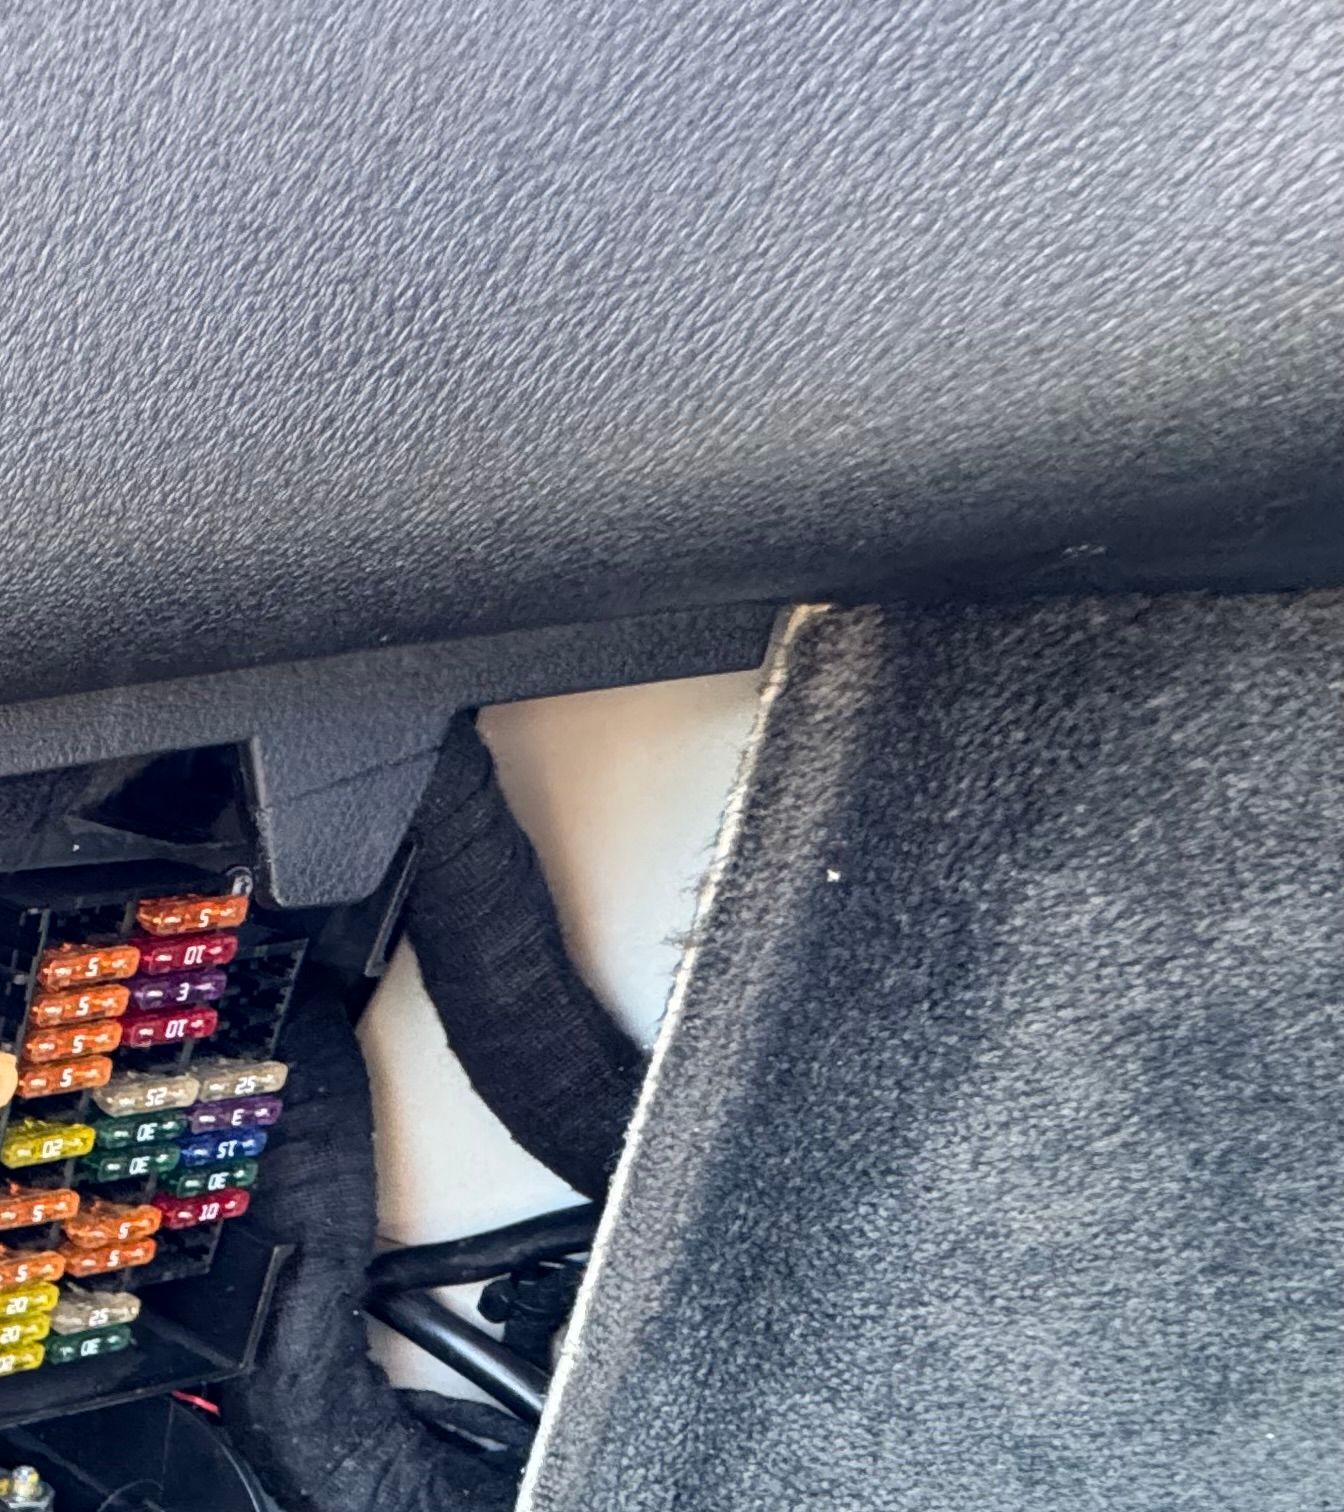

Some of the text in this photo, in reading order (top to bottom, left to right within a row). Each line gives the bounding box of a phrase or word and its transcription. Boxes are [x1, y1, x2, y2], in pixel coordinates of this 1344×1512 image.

[199, 909, 211, 928] 5
[183, 945, 207, 965] 10
[85, 957, 100, 977] 5
[76, 996, 90, 1016] 5
[165, 1019, 188, 1039] 10
[72, 1035, 85, 1054] 5
[60, 1067, 73, 1087] 5
[31, 1204, 44, 1223] 5
[198, 1202, 221, 1222] 10
[117, 1221, 130, 1240] 5
[107, 1249, 119, 1268] 5
[15, 1264, 28, 1283] 5
[5, 1296, 29, 1315] 20
